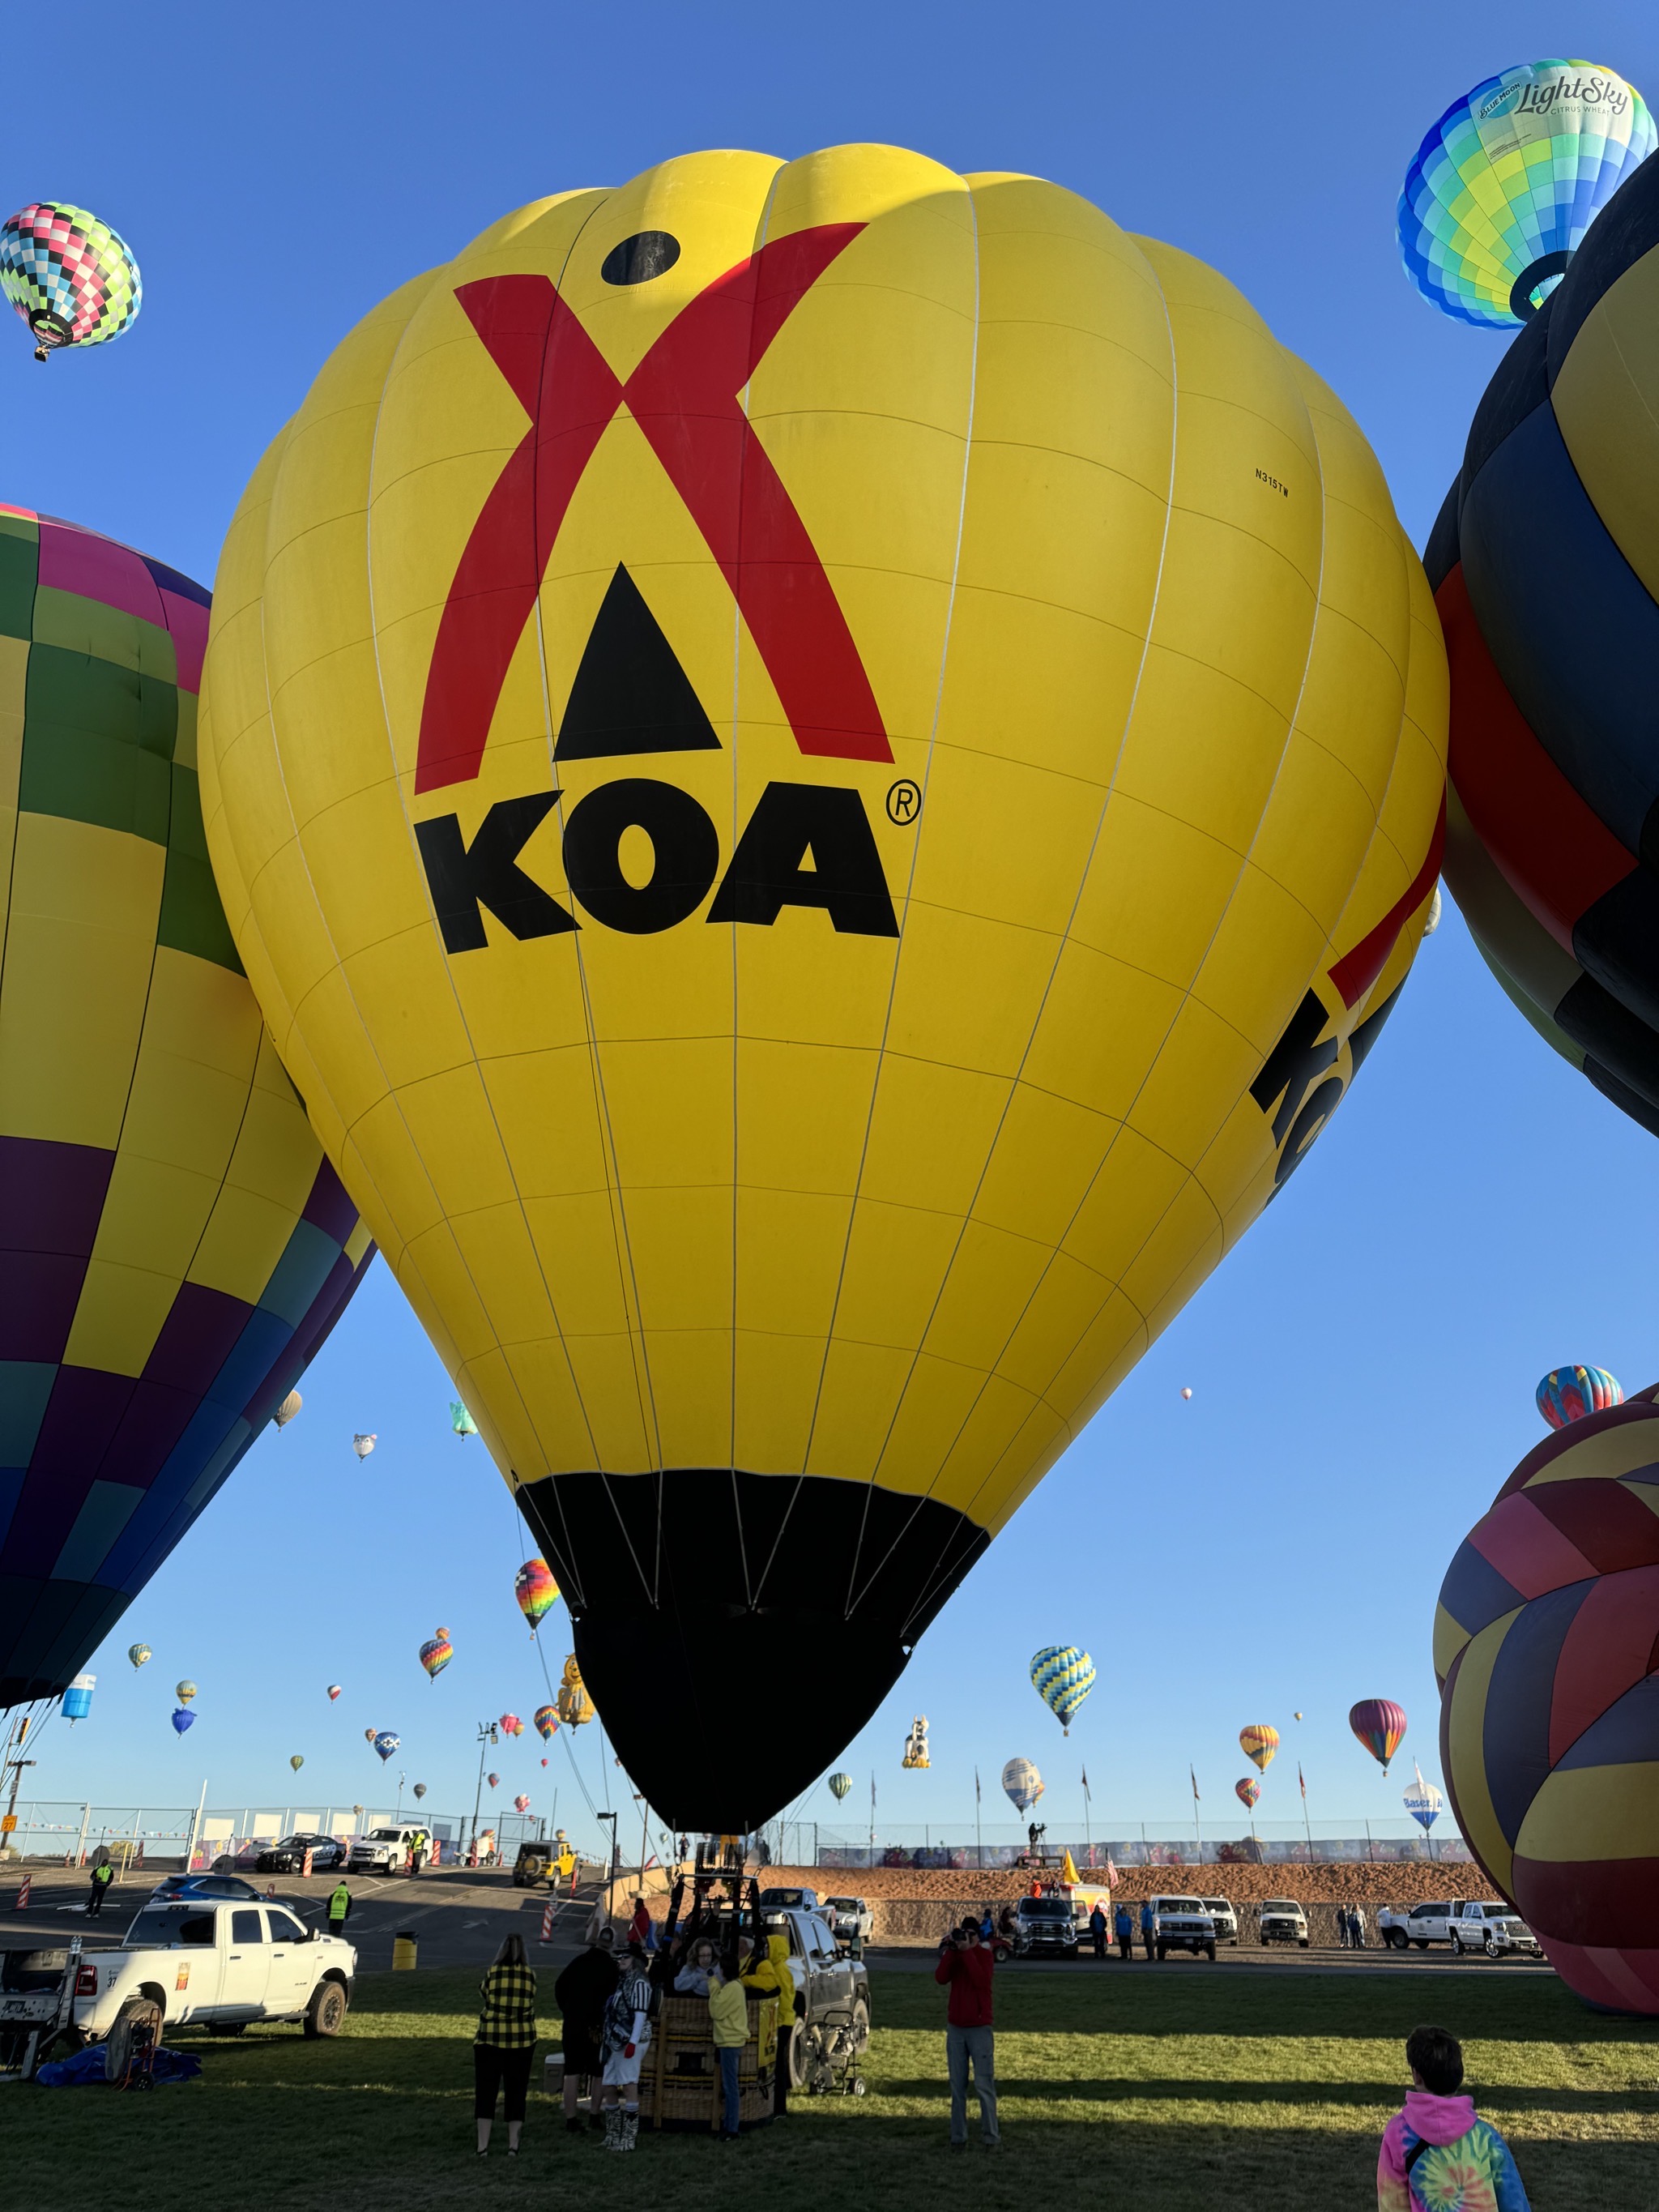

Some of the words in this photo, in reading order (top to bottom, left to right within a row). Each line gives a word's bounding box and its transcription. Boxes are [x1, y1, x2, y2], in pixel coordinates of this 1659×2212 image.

[1480, 99, 1499, 120] BLUE
[1498, 82, 1521, 102] MOON
[1550, 106, 1580, 115] CITRUS
[1584, 106, 1610, 116] WHEAT
[1256, 468, 1289, 497] N315TW
[108, 1977, 117, 1988] 37
